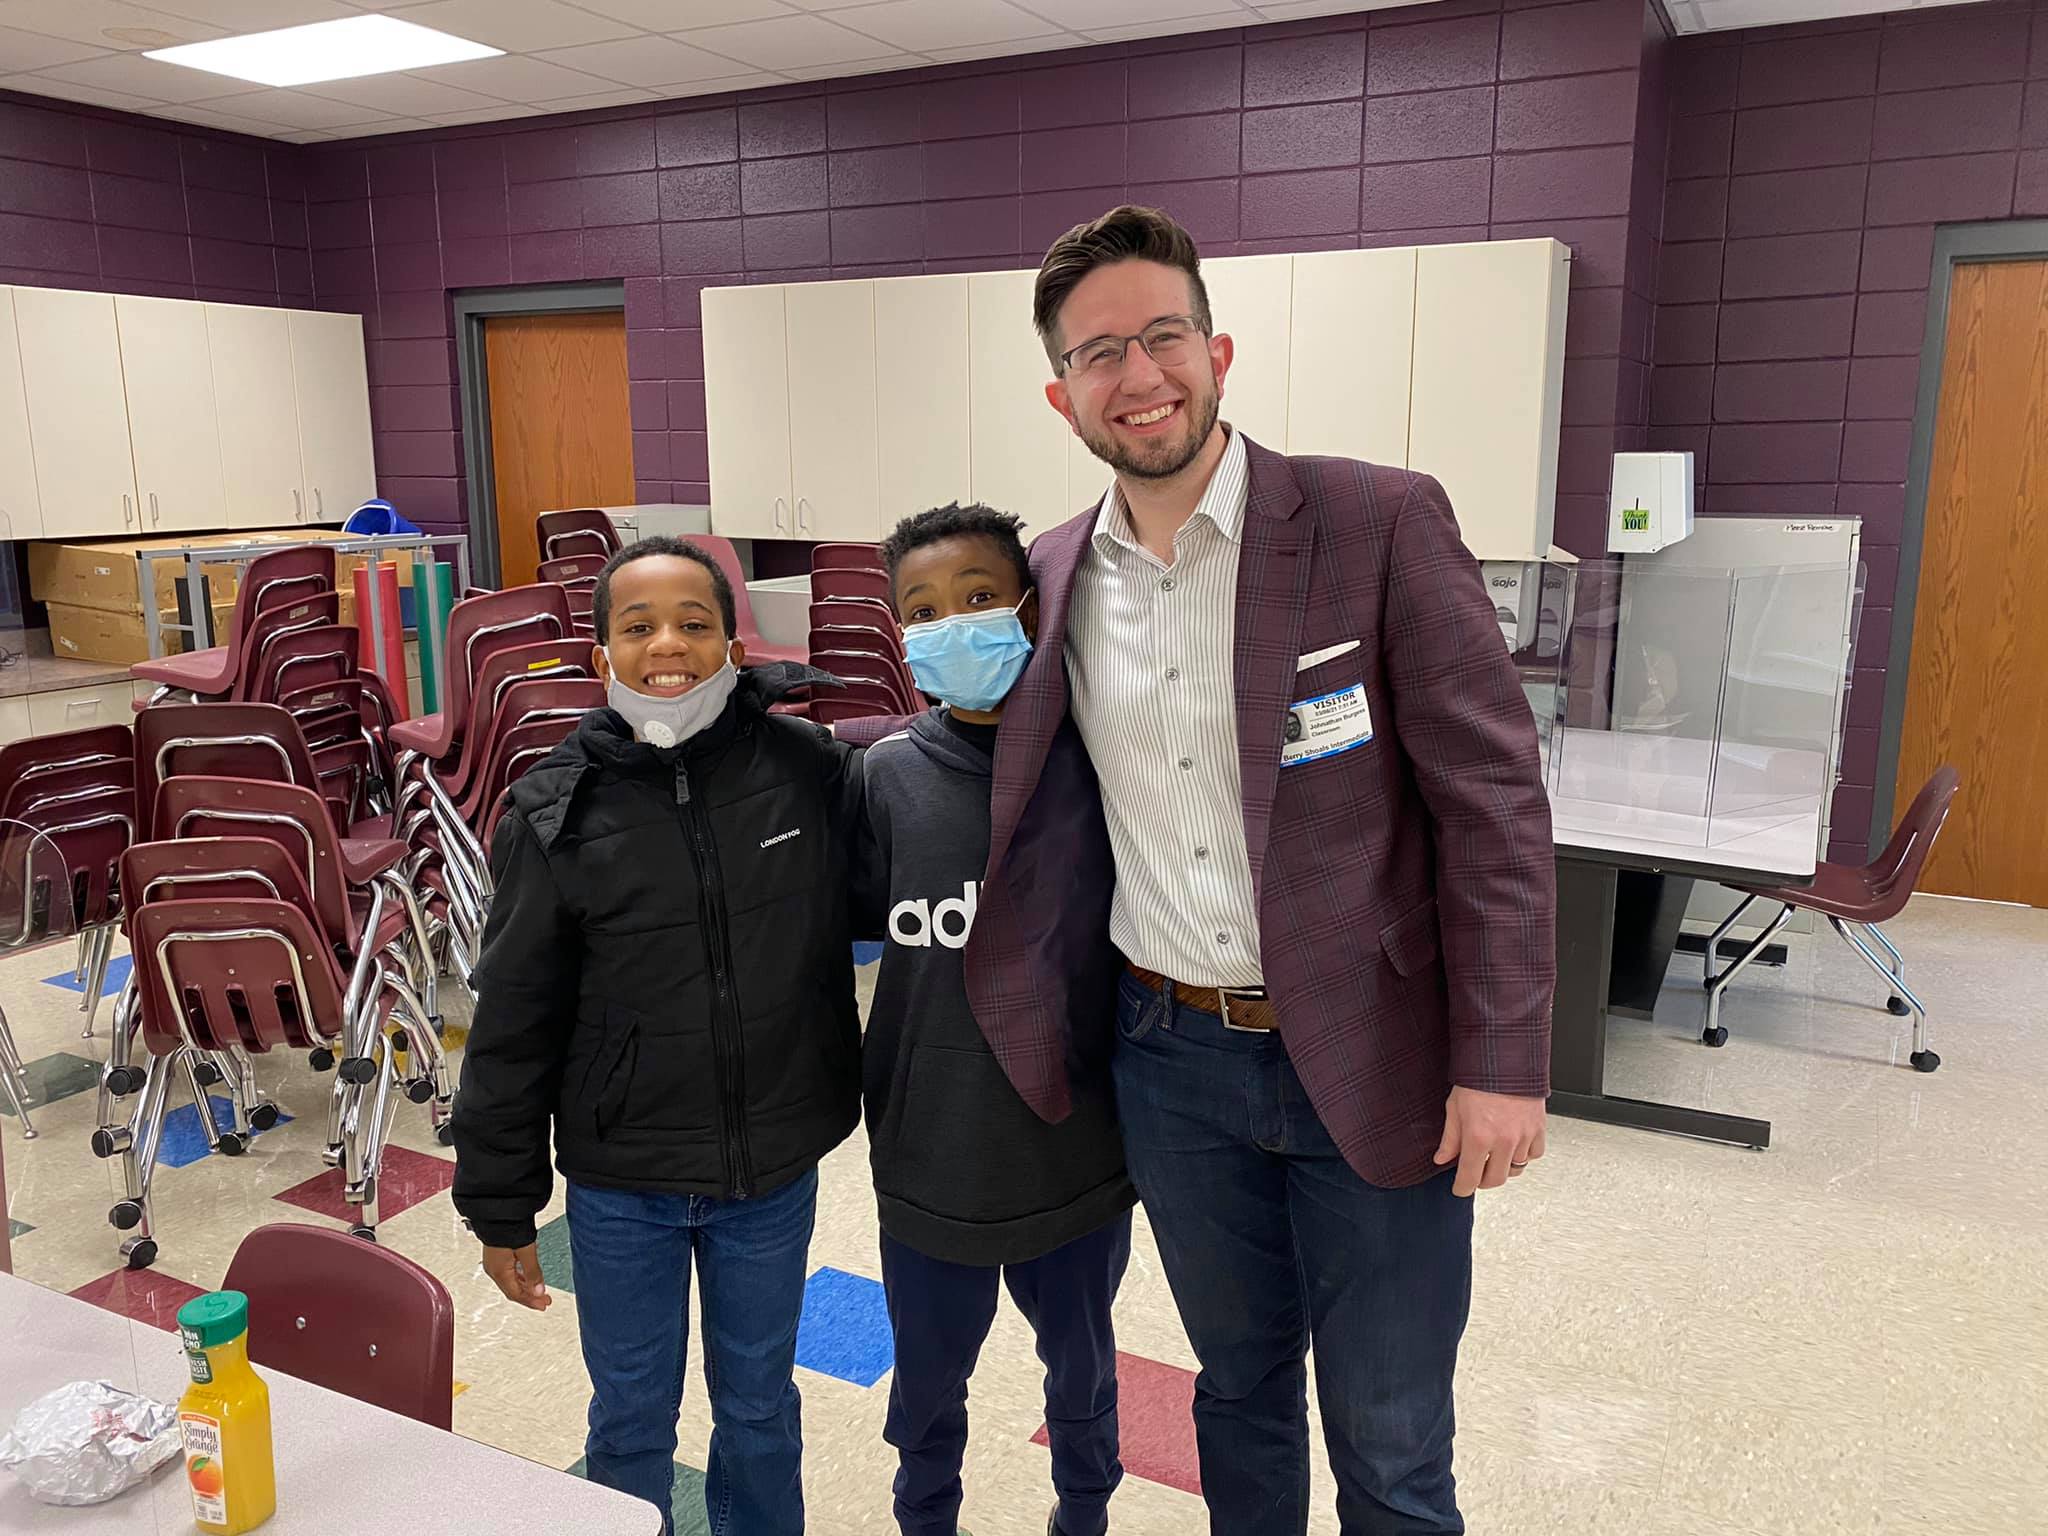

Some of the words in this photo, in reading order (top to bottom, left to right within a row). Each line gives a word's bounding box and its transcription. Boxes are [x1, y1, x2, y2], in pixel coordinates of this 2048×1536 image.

[1313, 692, 1356, 710] VISITOR
[1283, 751, 1304, 762] Berry
[1304, 745, 1329, 756] Shoals
[889, 881, 985, 949] ad
[184, 1422, 217, 1443] Simply
[185, 1437, 219, 1455] Orange
